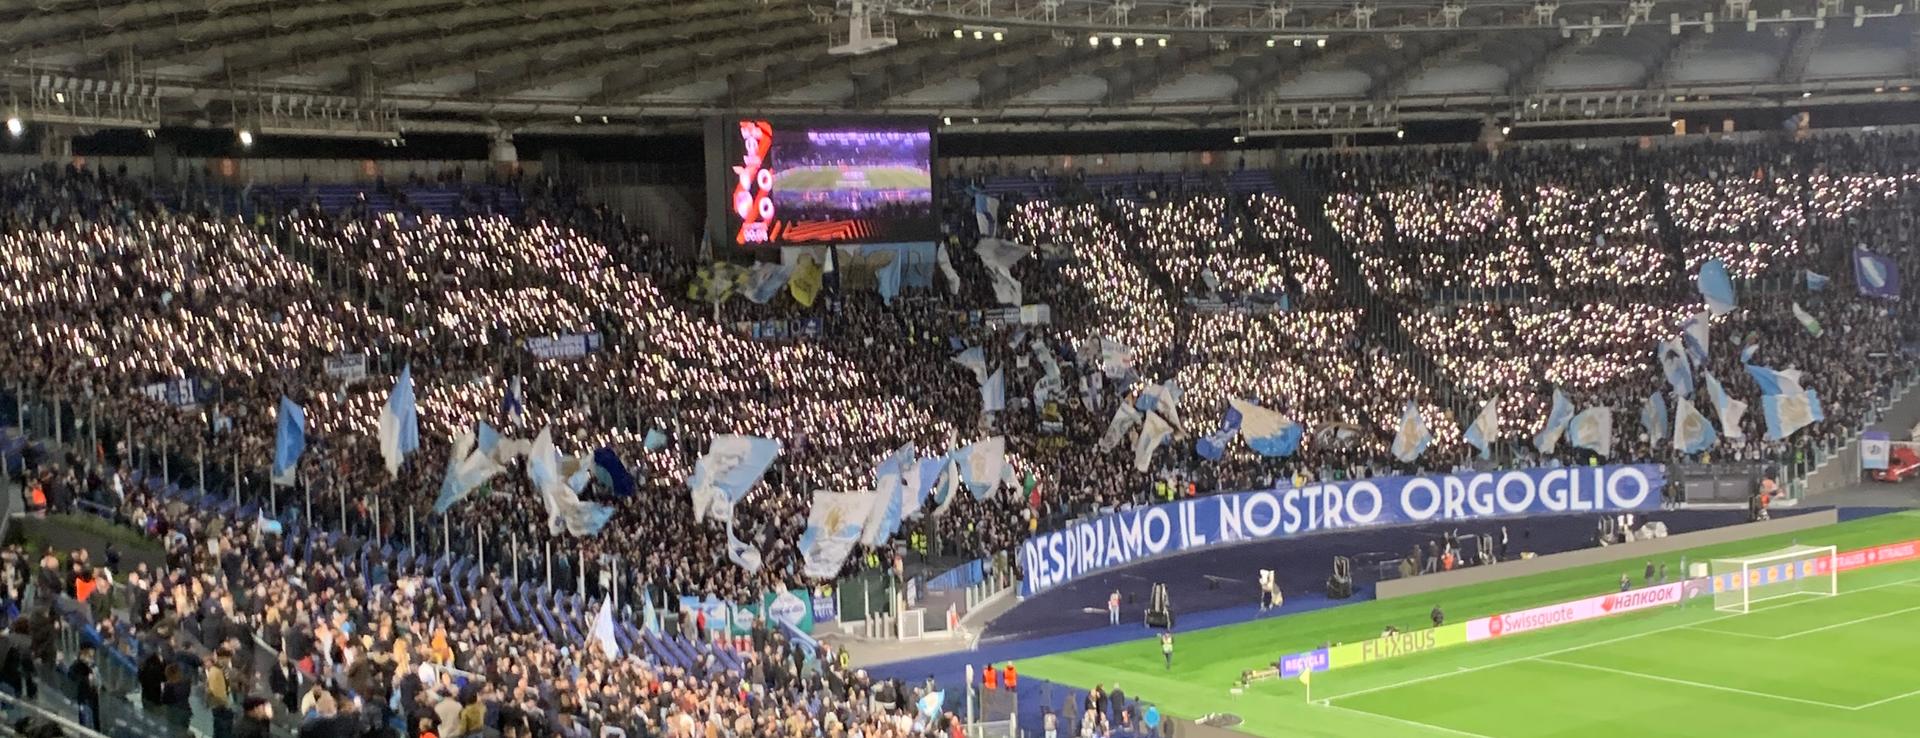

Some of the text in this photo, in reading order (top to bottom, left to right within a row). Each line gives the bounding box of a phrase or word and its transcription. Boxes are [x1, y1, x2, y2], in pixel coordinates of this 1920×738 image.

[1026, 467, 1649, 593] RESPIRIAMO IL NOSTRO ORGOGLIO
[1504, 607, 1573, 630] Swissquote
[1285, 653, 1326, 672] RECYCLE
